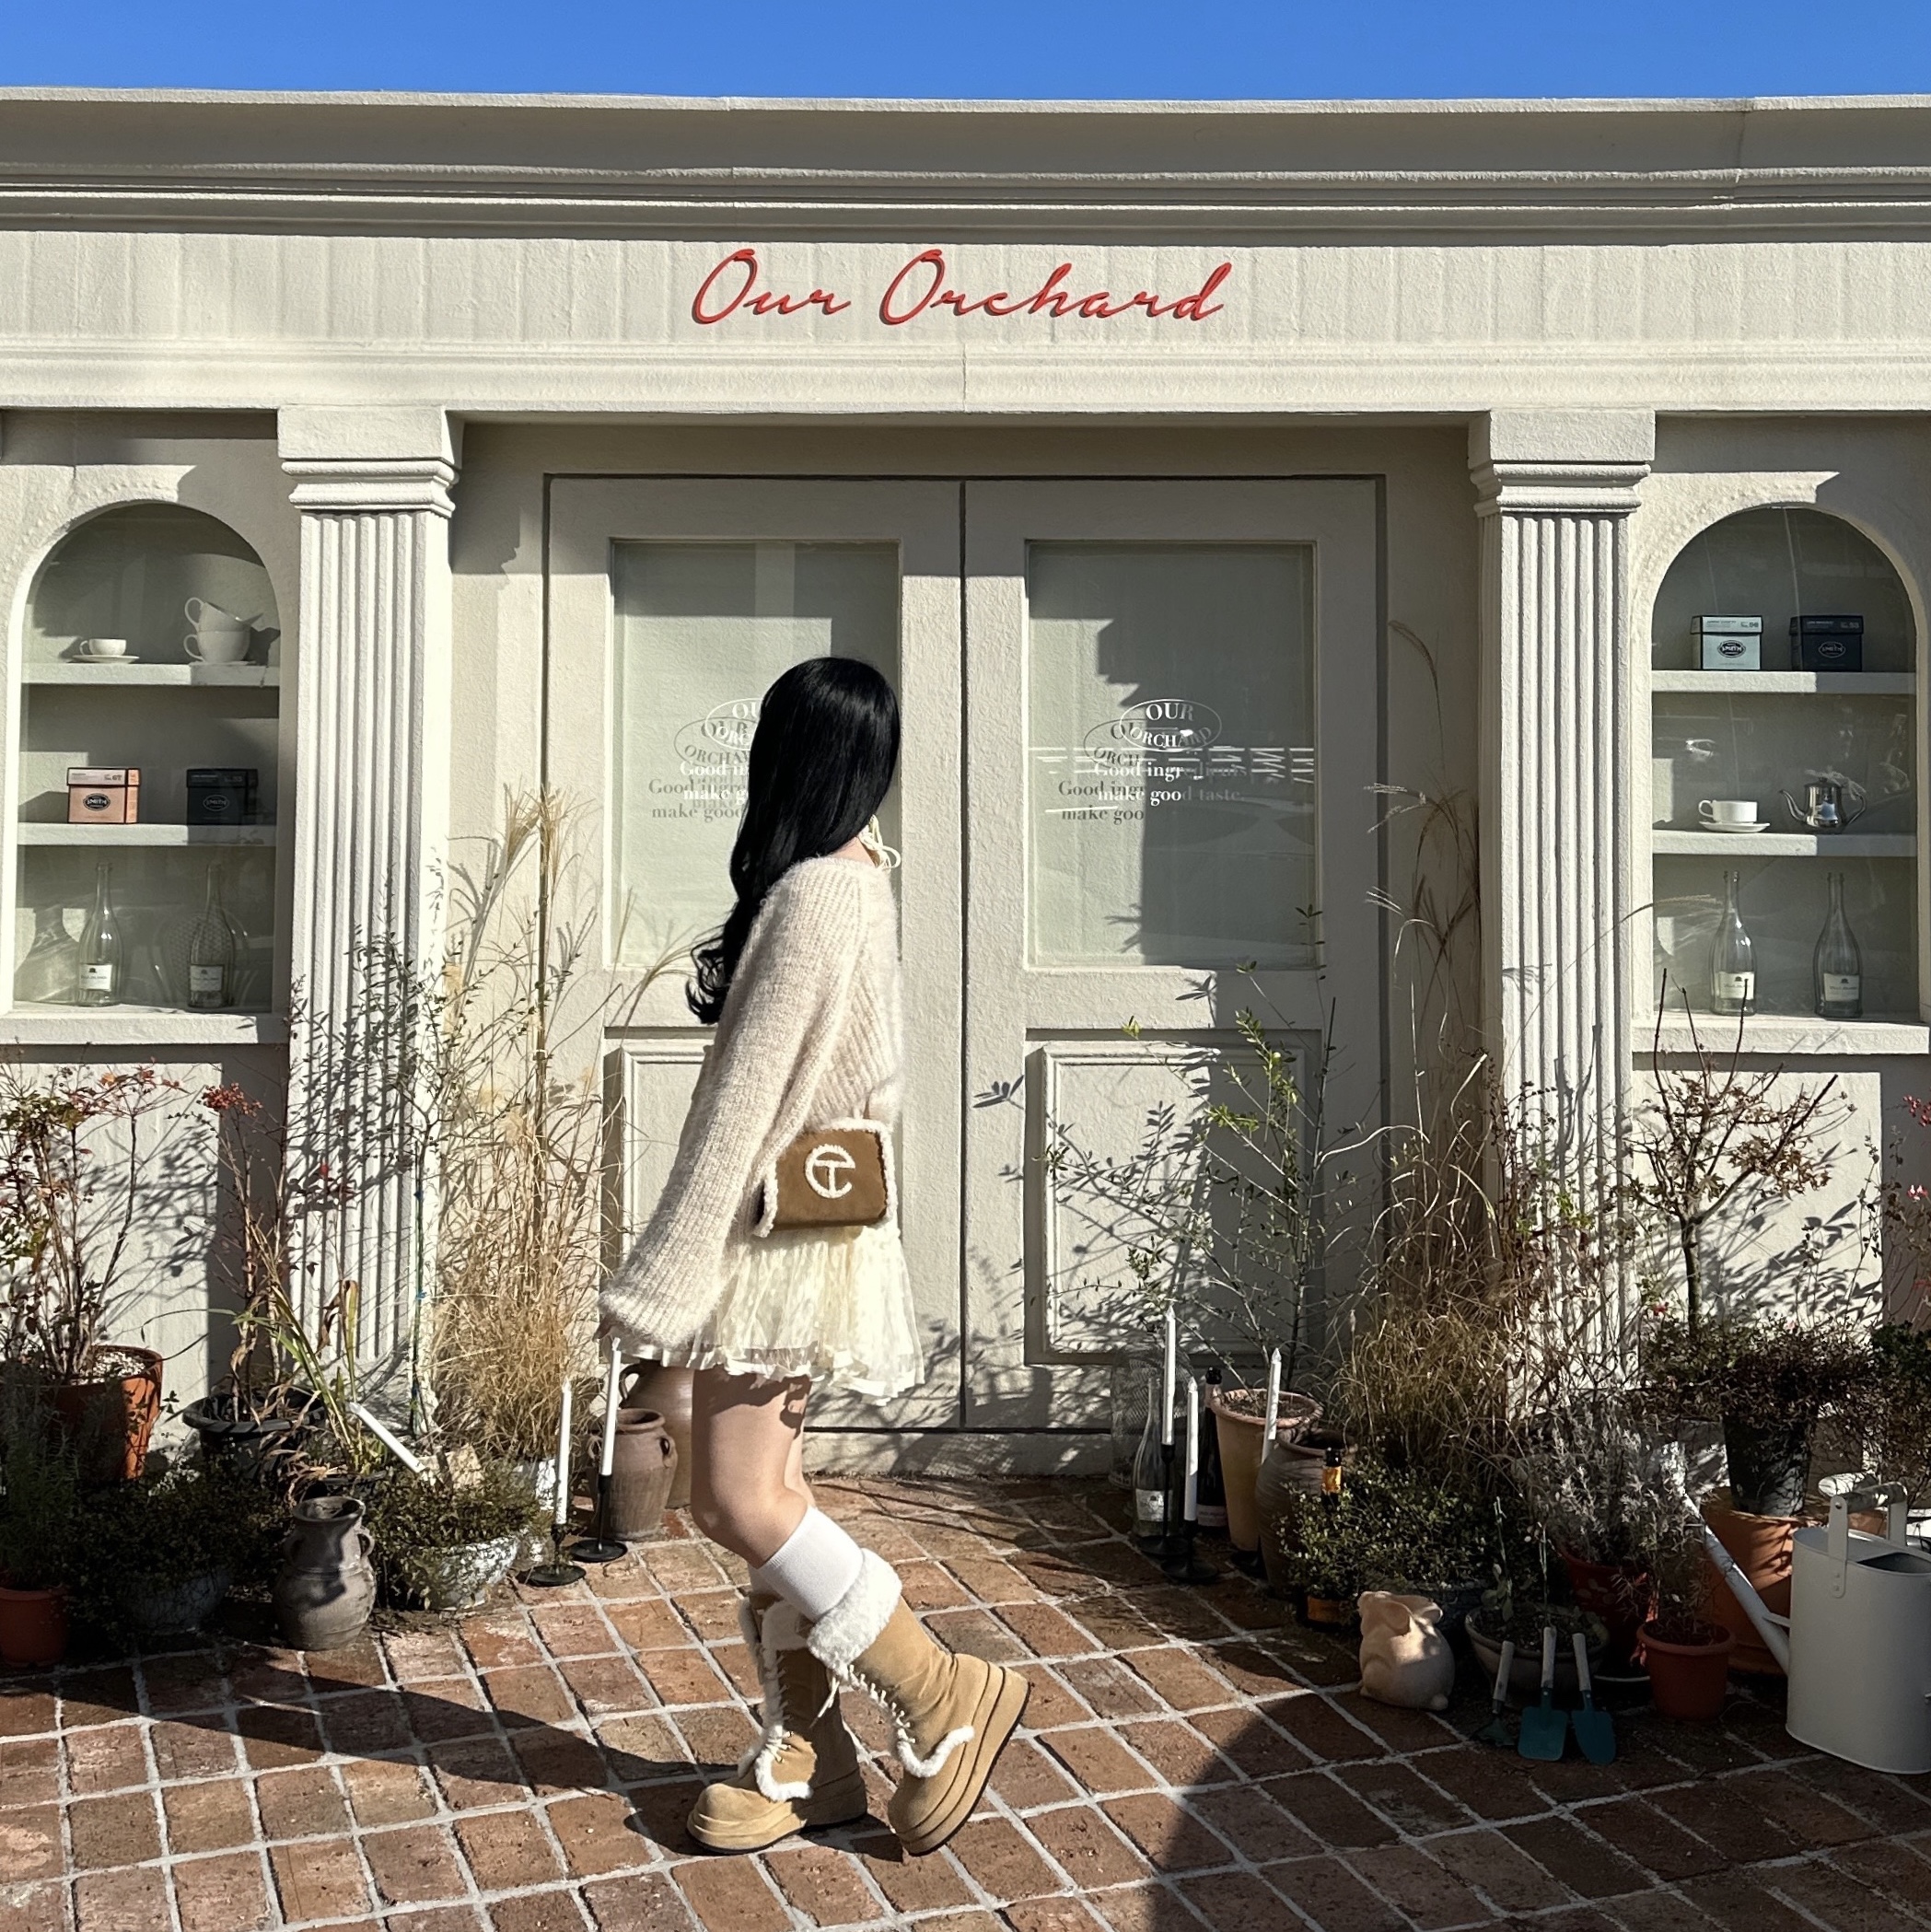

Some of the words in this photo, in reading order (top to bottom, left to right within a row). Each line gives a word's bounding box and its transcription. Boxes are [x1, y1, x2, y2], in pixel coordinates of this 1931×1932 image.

[692, 249, 851, 324] Our
[878, 249, 1232, 325] Orchard
[732, 703, 758, 719] OU
[1146, 703, 1194, 721] OUR
[1130, 726, 1212, 748] ORCHARD
[680, 761, 727, 775] Good
[1094, 762, 1141, 776] Good
[683, 785, 730, 800] make
[1099, 786, 1145, 801] make
[1150, 786, 1192, 807] good
[1113, 809, 1144, 826] goo
